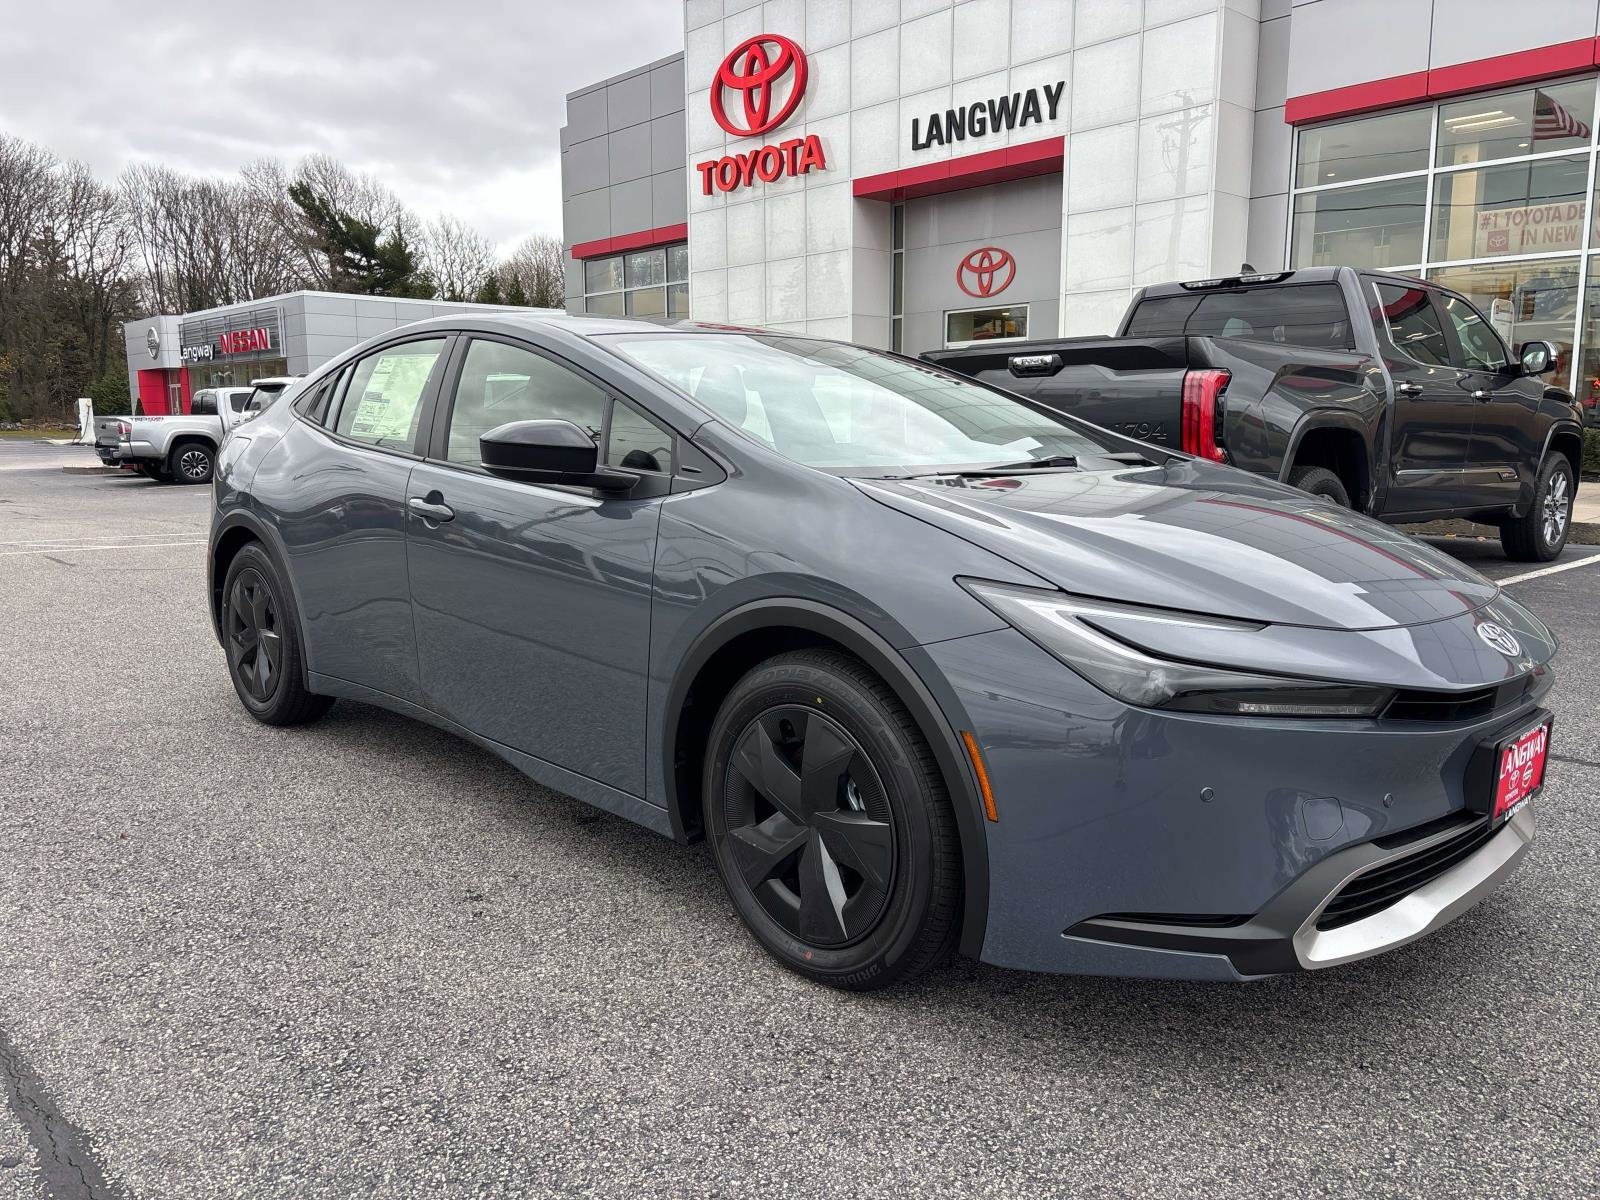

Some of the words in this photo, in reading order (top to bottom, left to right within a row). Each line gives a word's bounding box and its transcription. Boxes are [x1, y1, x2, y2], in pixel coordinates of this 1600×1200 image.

[911, 81, 1066, 151] LANGWAY
[697, 134, 826, 195] TOYOTA
[1480, 213, 1498, 230] #1
[1504, 206, 1562, 227] TOYOTA
[1566, 203, 1586, 221] DE
[1520, 228, 1538, 246] IN
[1542, 225, 1578, 243] NEW
[180, 343, 215, 362] Langway
[219, 327, 271, 354] NISSAN
[1114, 423, 1169, 440] 794
[1500, 731, 1548, 780] LANGWAY
[1505, 793, 1533, 821] LANGWAY
